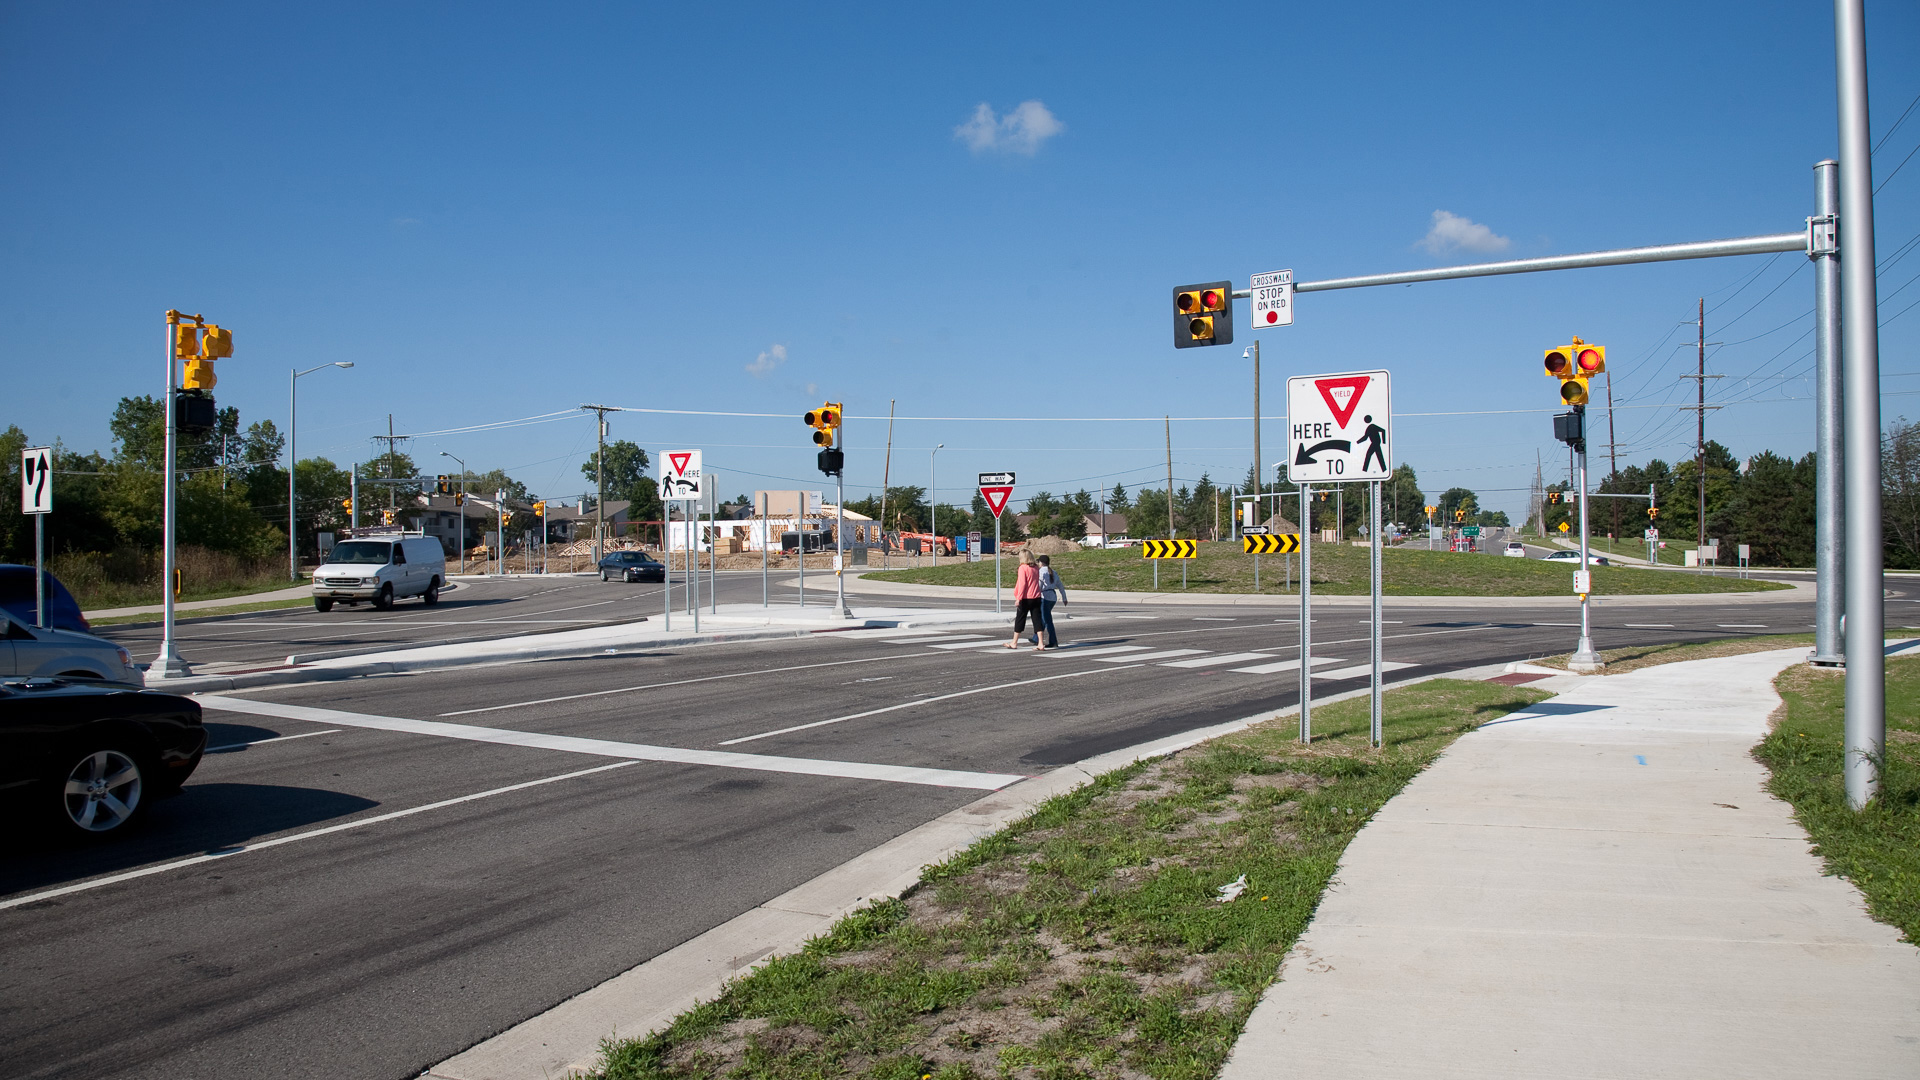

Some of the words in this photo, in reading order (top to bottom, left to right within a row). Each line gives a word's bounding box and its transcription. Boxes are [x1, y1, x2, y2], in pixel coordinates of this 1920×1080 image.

[1252, 273, 1290, 287] CROSSWALK
[1260, 287, 1284, 300] STOP
[1257, 301, 1269, 311] ON
[1271, 299, 1286, 309] RED
[1334, 390, 1351, 398] YIELD
[1293, 422, 1332, 440] HERE
[1326, 458, 1345, 475] TO
[683, 469, 700, 478] HERE
[678, 487, 687, 495] TO
